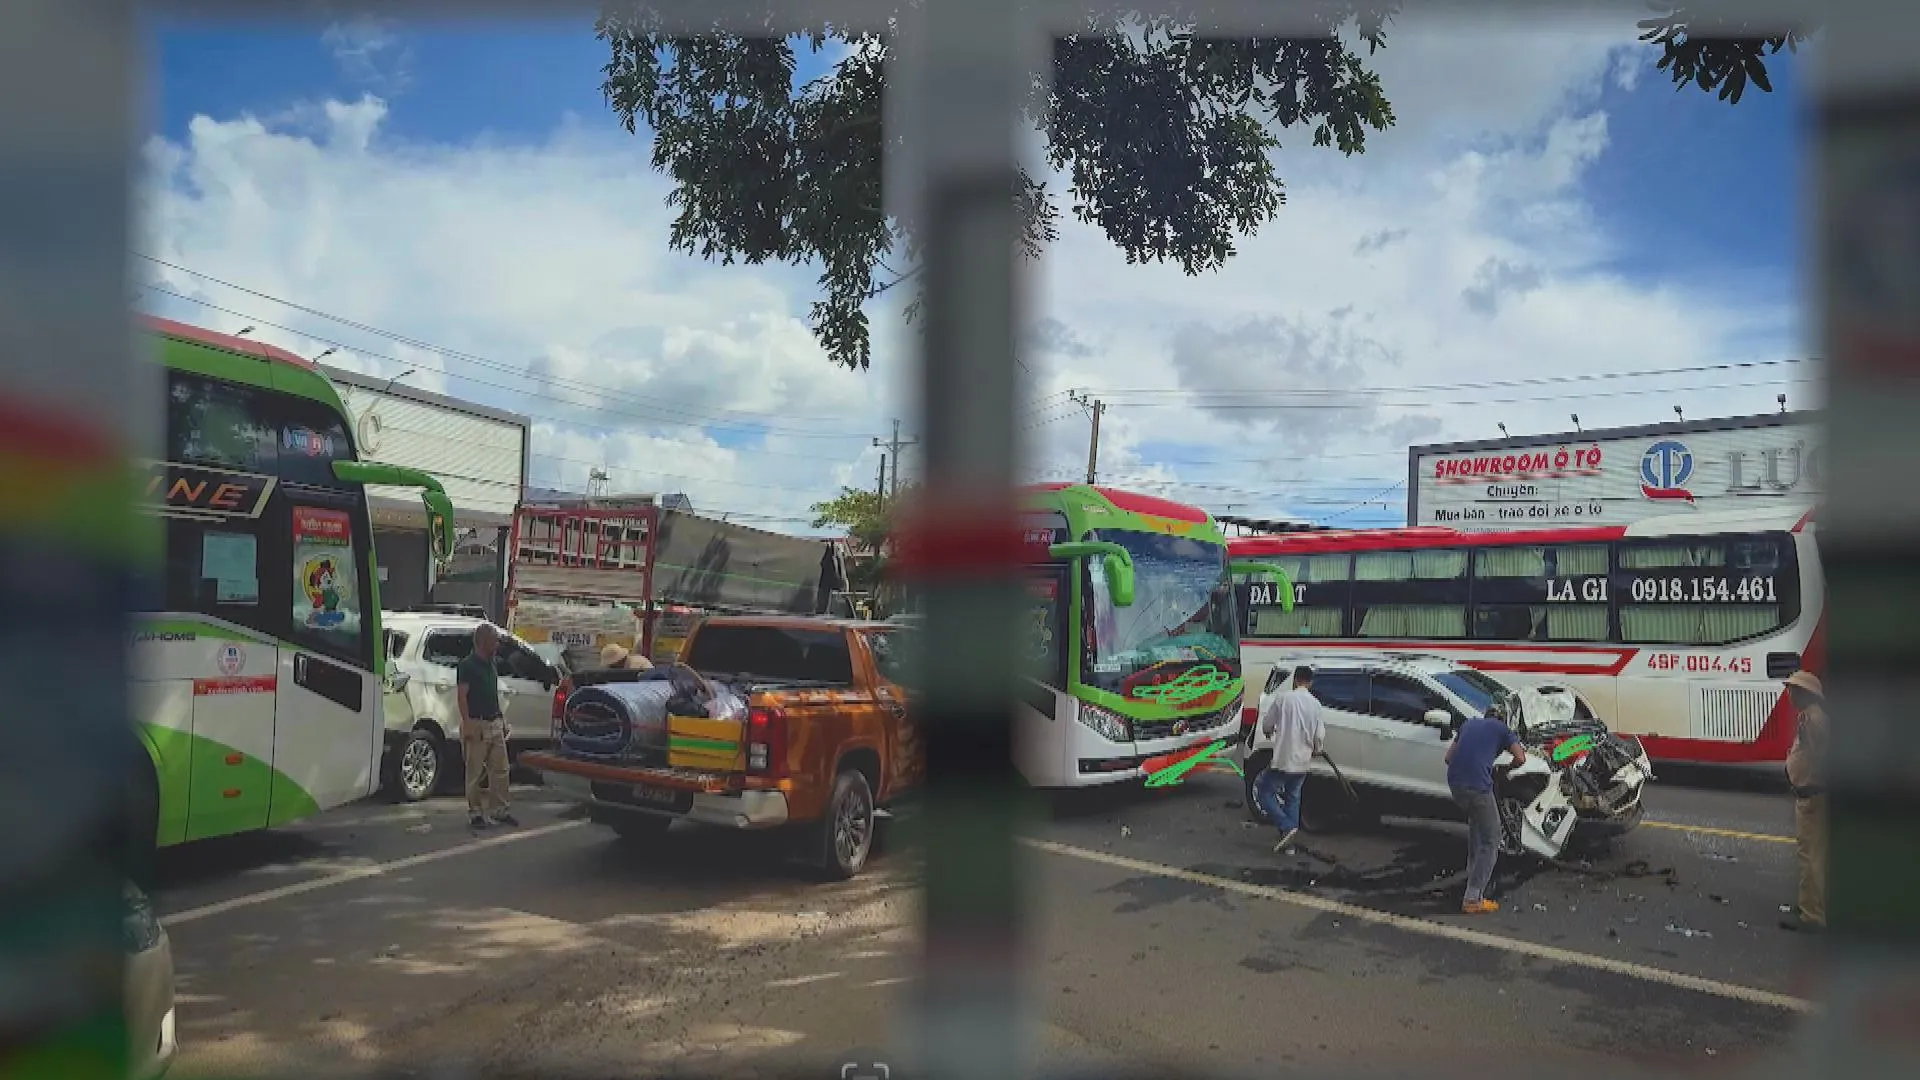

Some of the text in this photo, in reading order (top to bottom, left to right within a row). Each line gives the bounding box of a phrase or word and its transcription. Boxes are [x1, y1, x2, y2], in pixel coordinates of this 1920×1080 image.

[1435, 453, 1549, 478] SHOWROOM
[1435, 509, 1460, 521] Mua
[1546, 578, 1608, 601] LA GI
[1631, 576, 1777, 601] 0918.154.461
